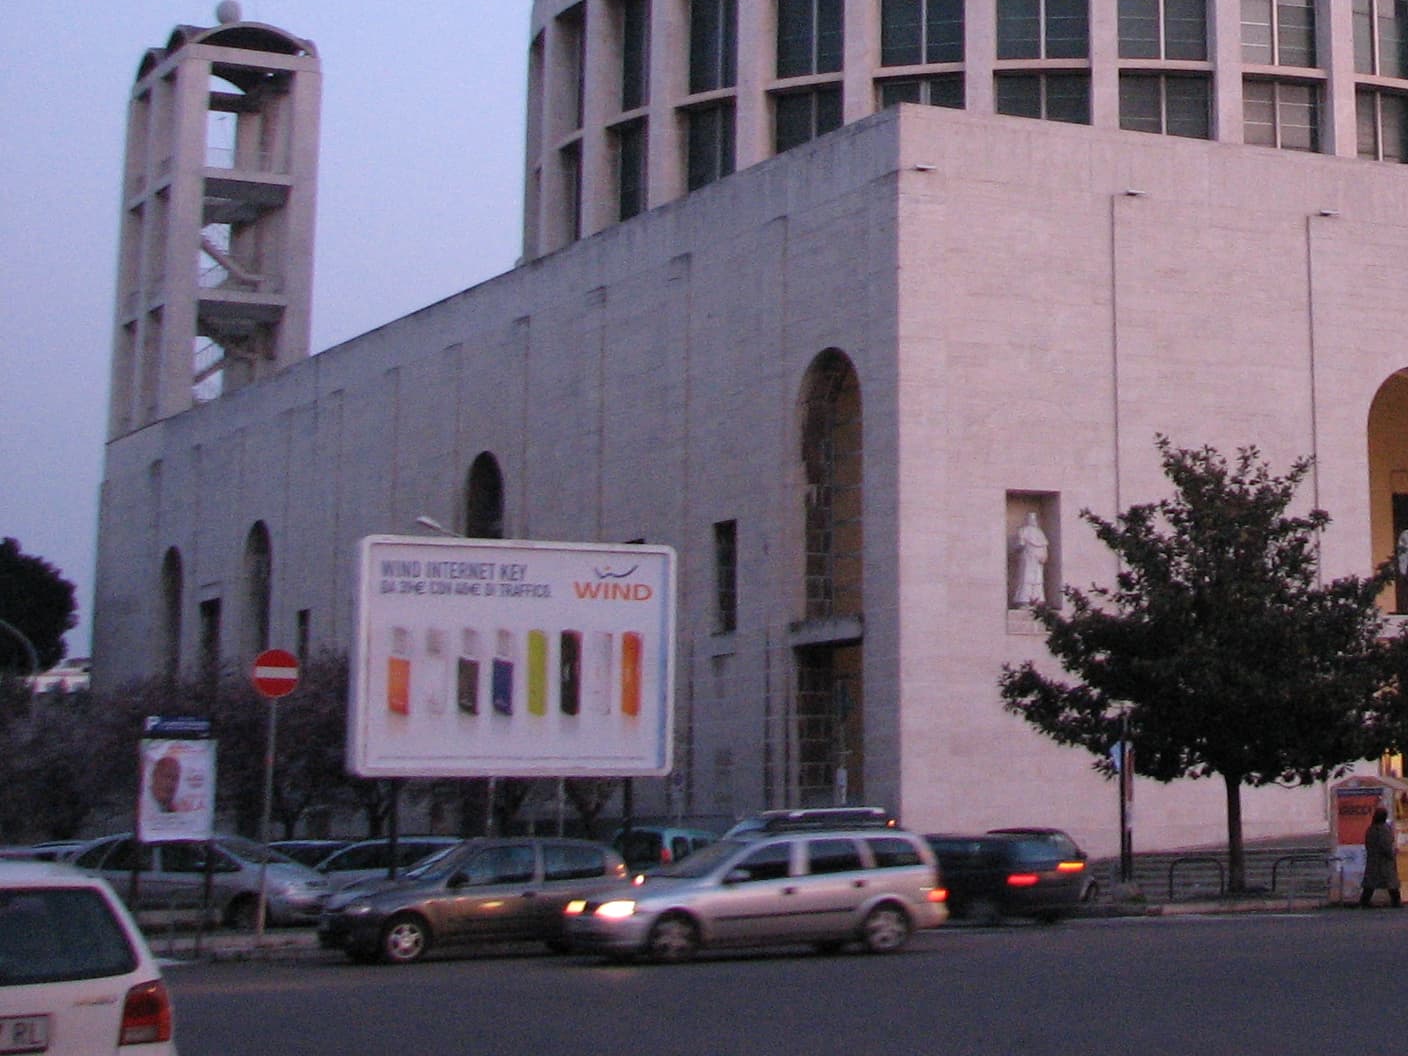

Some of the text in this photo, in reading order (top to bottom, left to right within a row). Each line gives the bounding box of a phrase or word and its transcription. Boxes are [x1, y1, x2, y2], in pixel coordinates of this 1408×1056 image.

[380, 560, 529, 582] WIND INTERNET KEY
[573, 581, 653, 601] WIND
